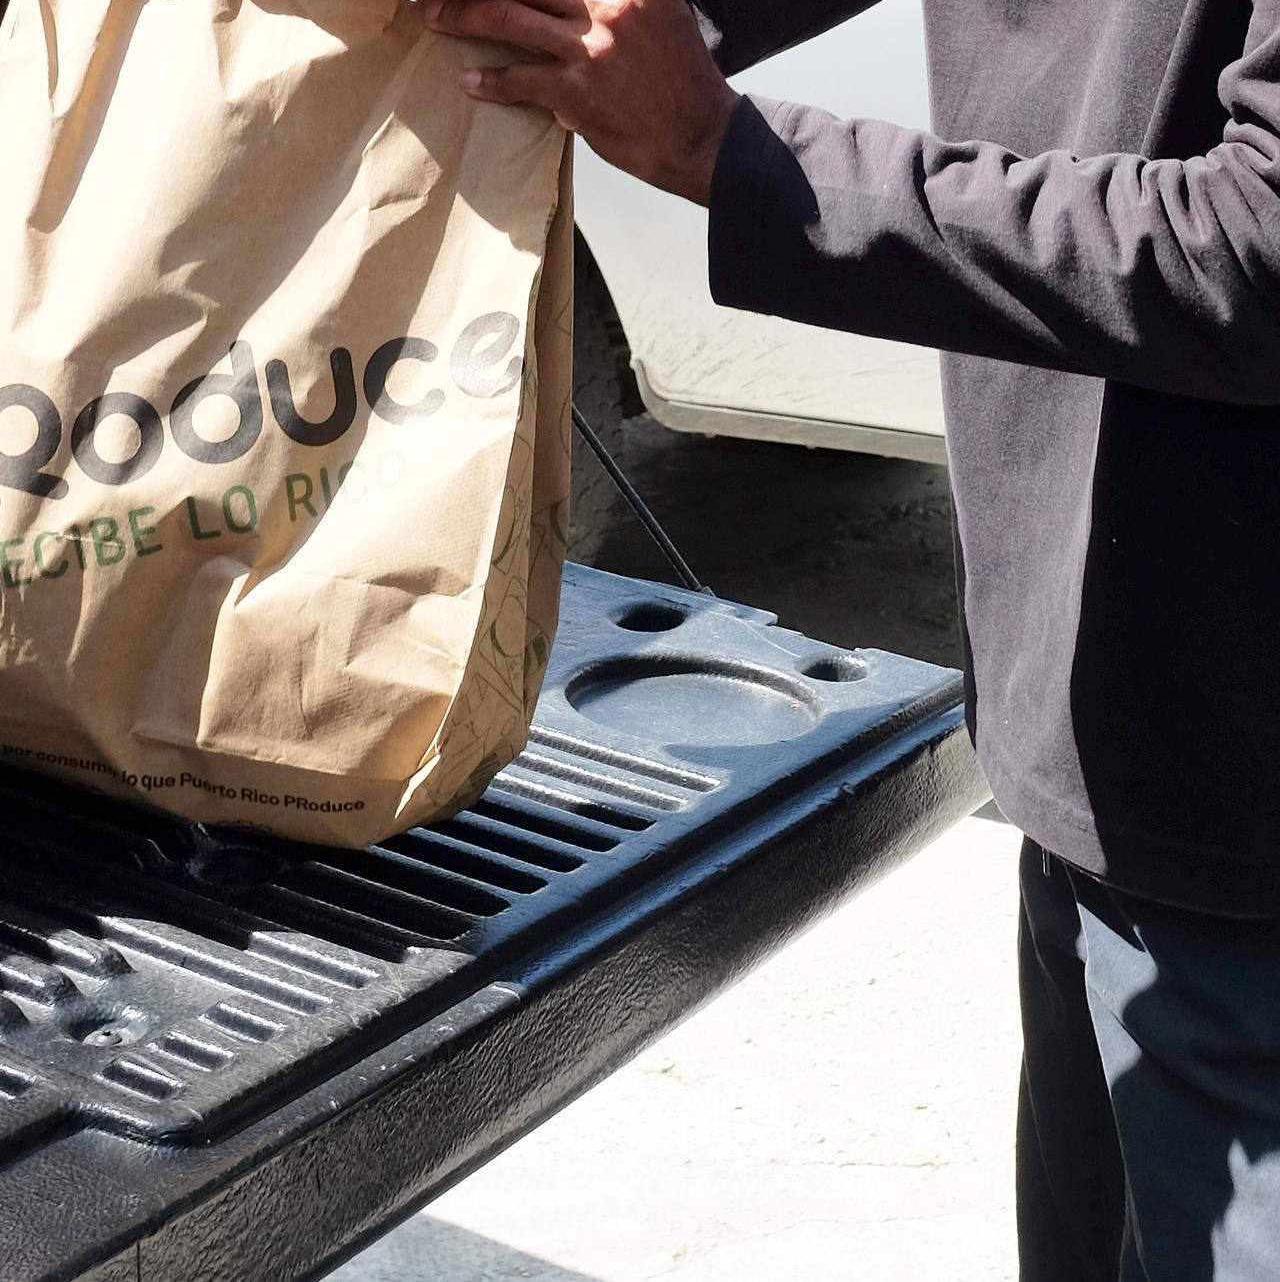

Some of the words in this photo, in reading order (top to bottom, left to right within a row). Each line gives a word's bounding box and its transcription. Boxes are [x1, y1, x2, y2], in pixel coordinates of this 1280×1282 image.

[186, 484, 258, 542] LO
[122, 769, 138, 787] lo
[141, 773, 176, 792] que
[180, 771, 237, 799] Puerto
[241, 787, 280, 806] Rico
[284, 794, 366, 813] PRoduce
